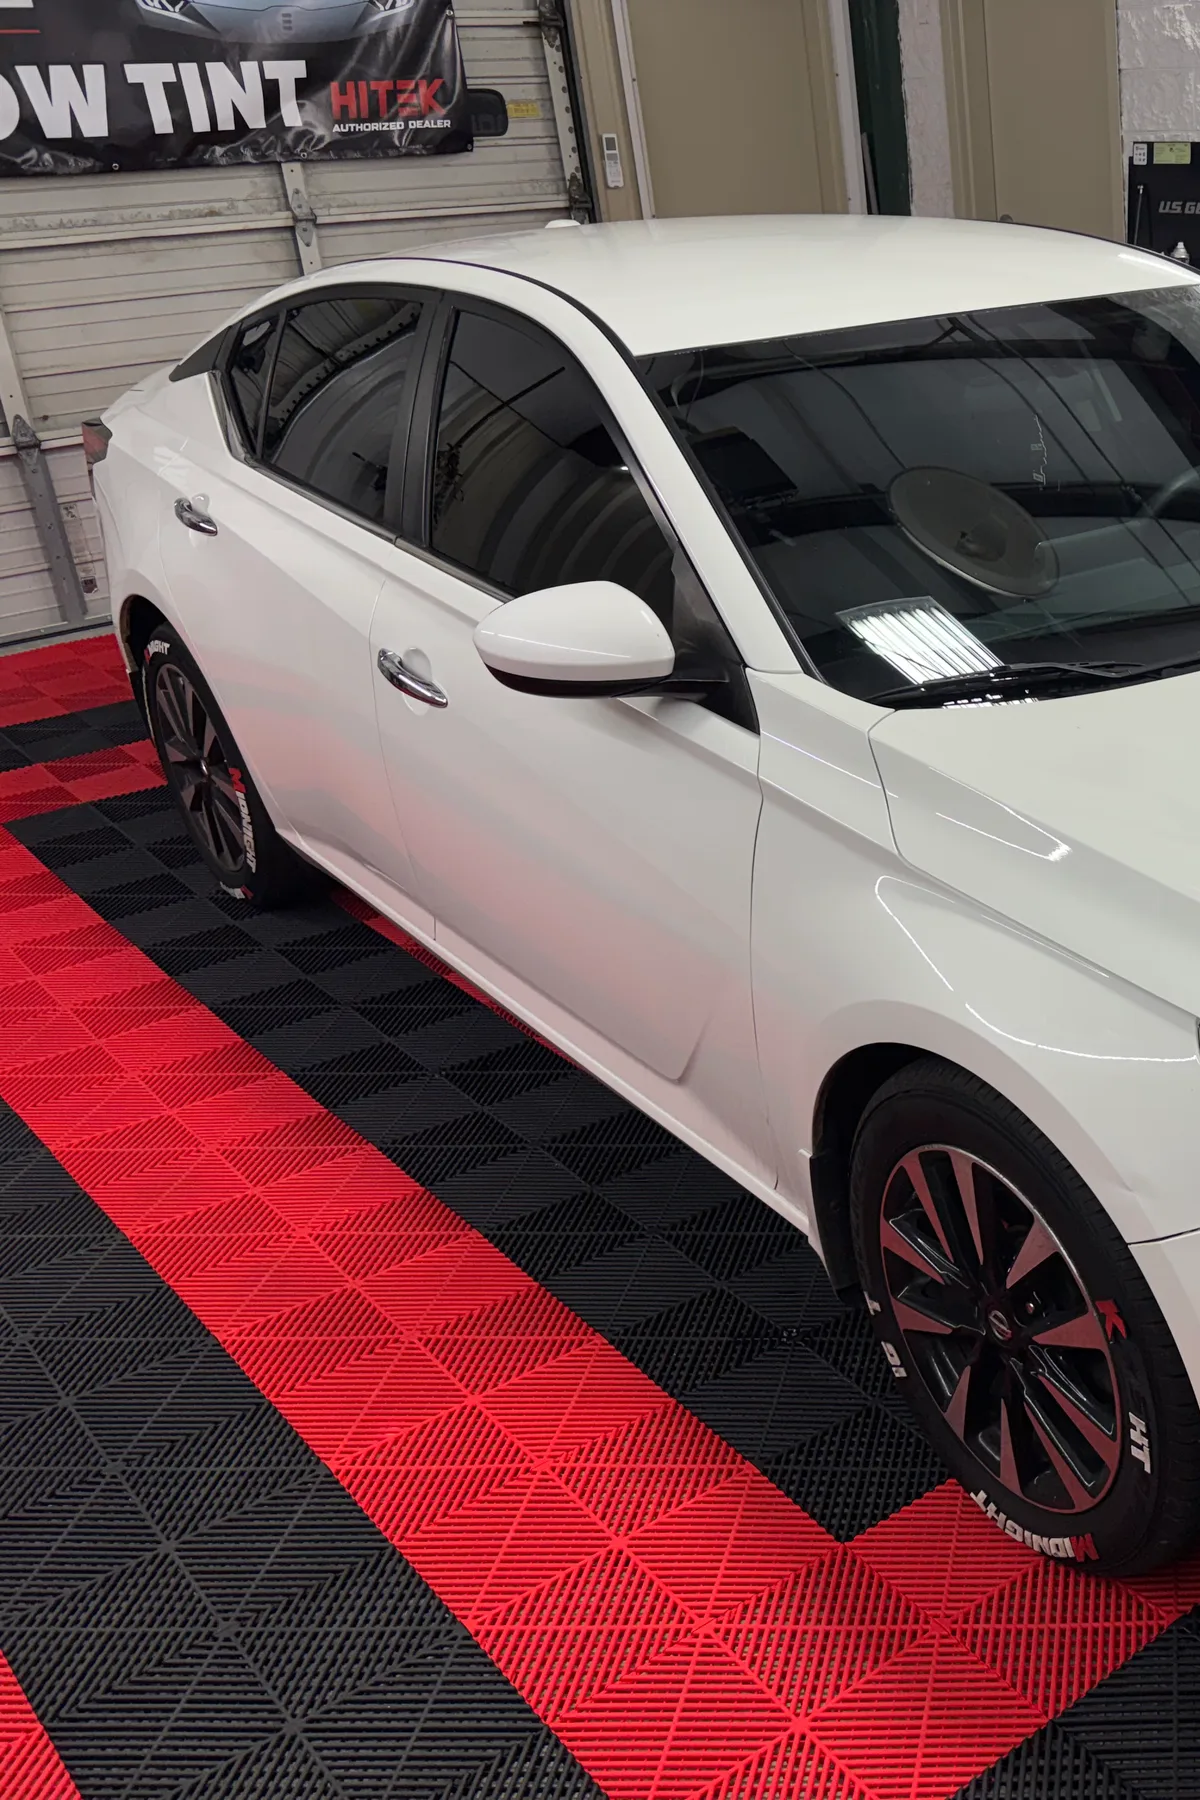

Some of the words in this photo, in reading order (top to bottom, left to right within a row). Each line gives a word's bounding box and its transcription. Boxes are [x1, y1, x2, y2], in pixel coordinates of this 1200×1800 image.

[125, 60, 308, 135] TINT
[330, 78, 446, 120] HITEK
[333, 121, 405, 133] AUTHORIZED
[408, 119, 451, 129] DEALER
[228, 767, 257, 874] MIDNIGHT
[1128, 1411, 1153, 1475] HT
[969, 1489, 1100, 1563] MIDNIGHT
